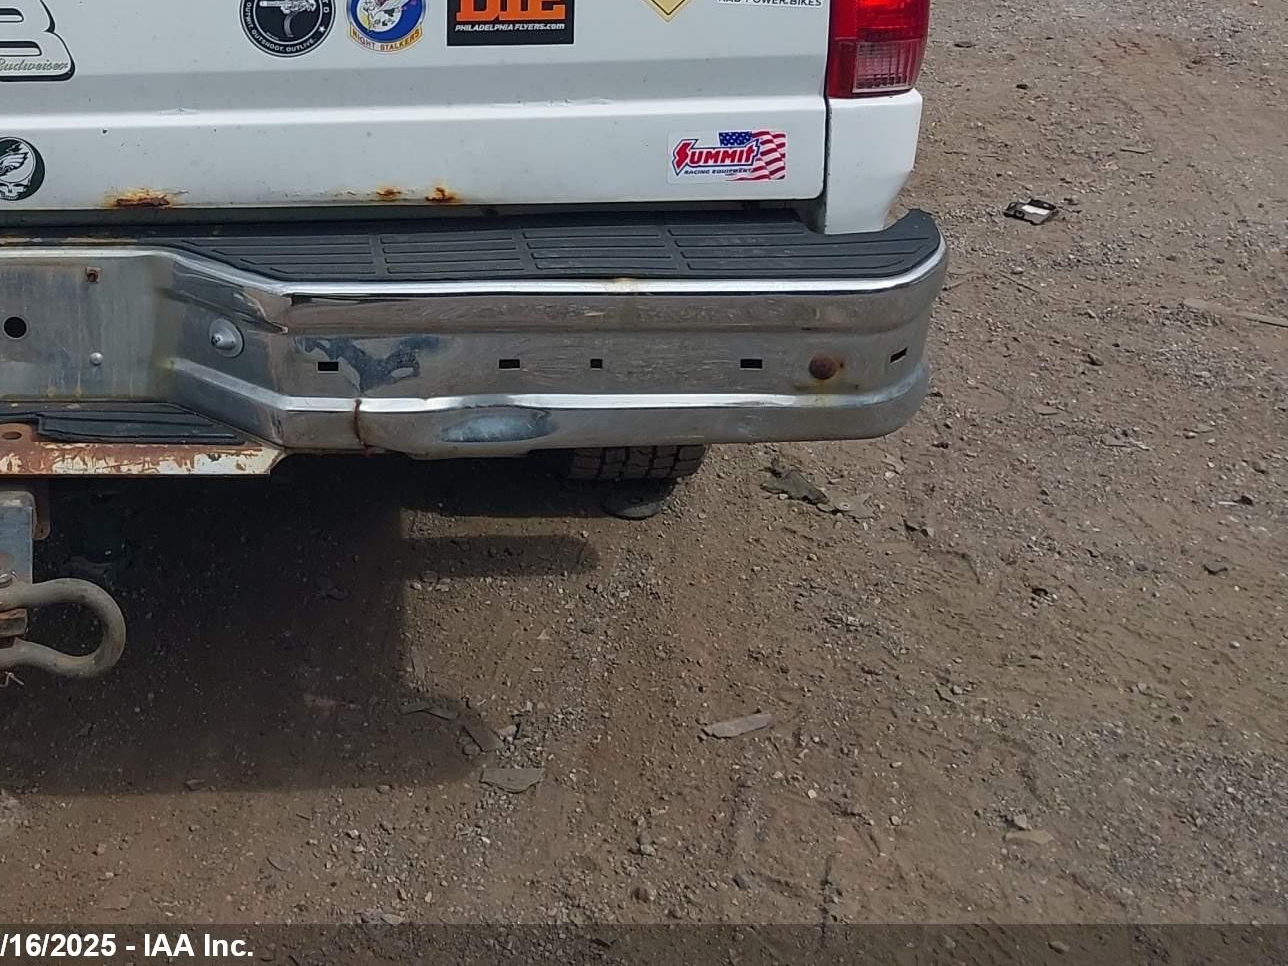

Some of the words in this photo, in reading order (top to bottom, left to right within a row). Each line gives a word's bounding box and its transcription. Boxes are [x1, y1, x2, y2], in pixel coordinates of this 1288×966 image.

[455, 24, 513, 32] PHILADELPHIA
[352, 29, 376, 49] NIGHT
[380, 28, 420, 51] STALKERS
